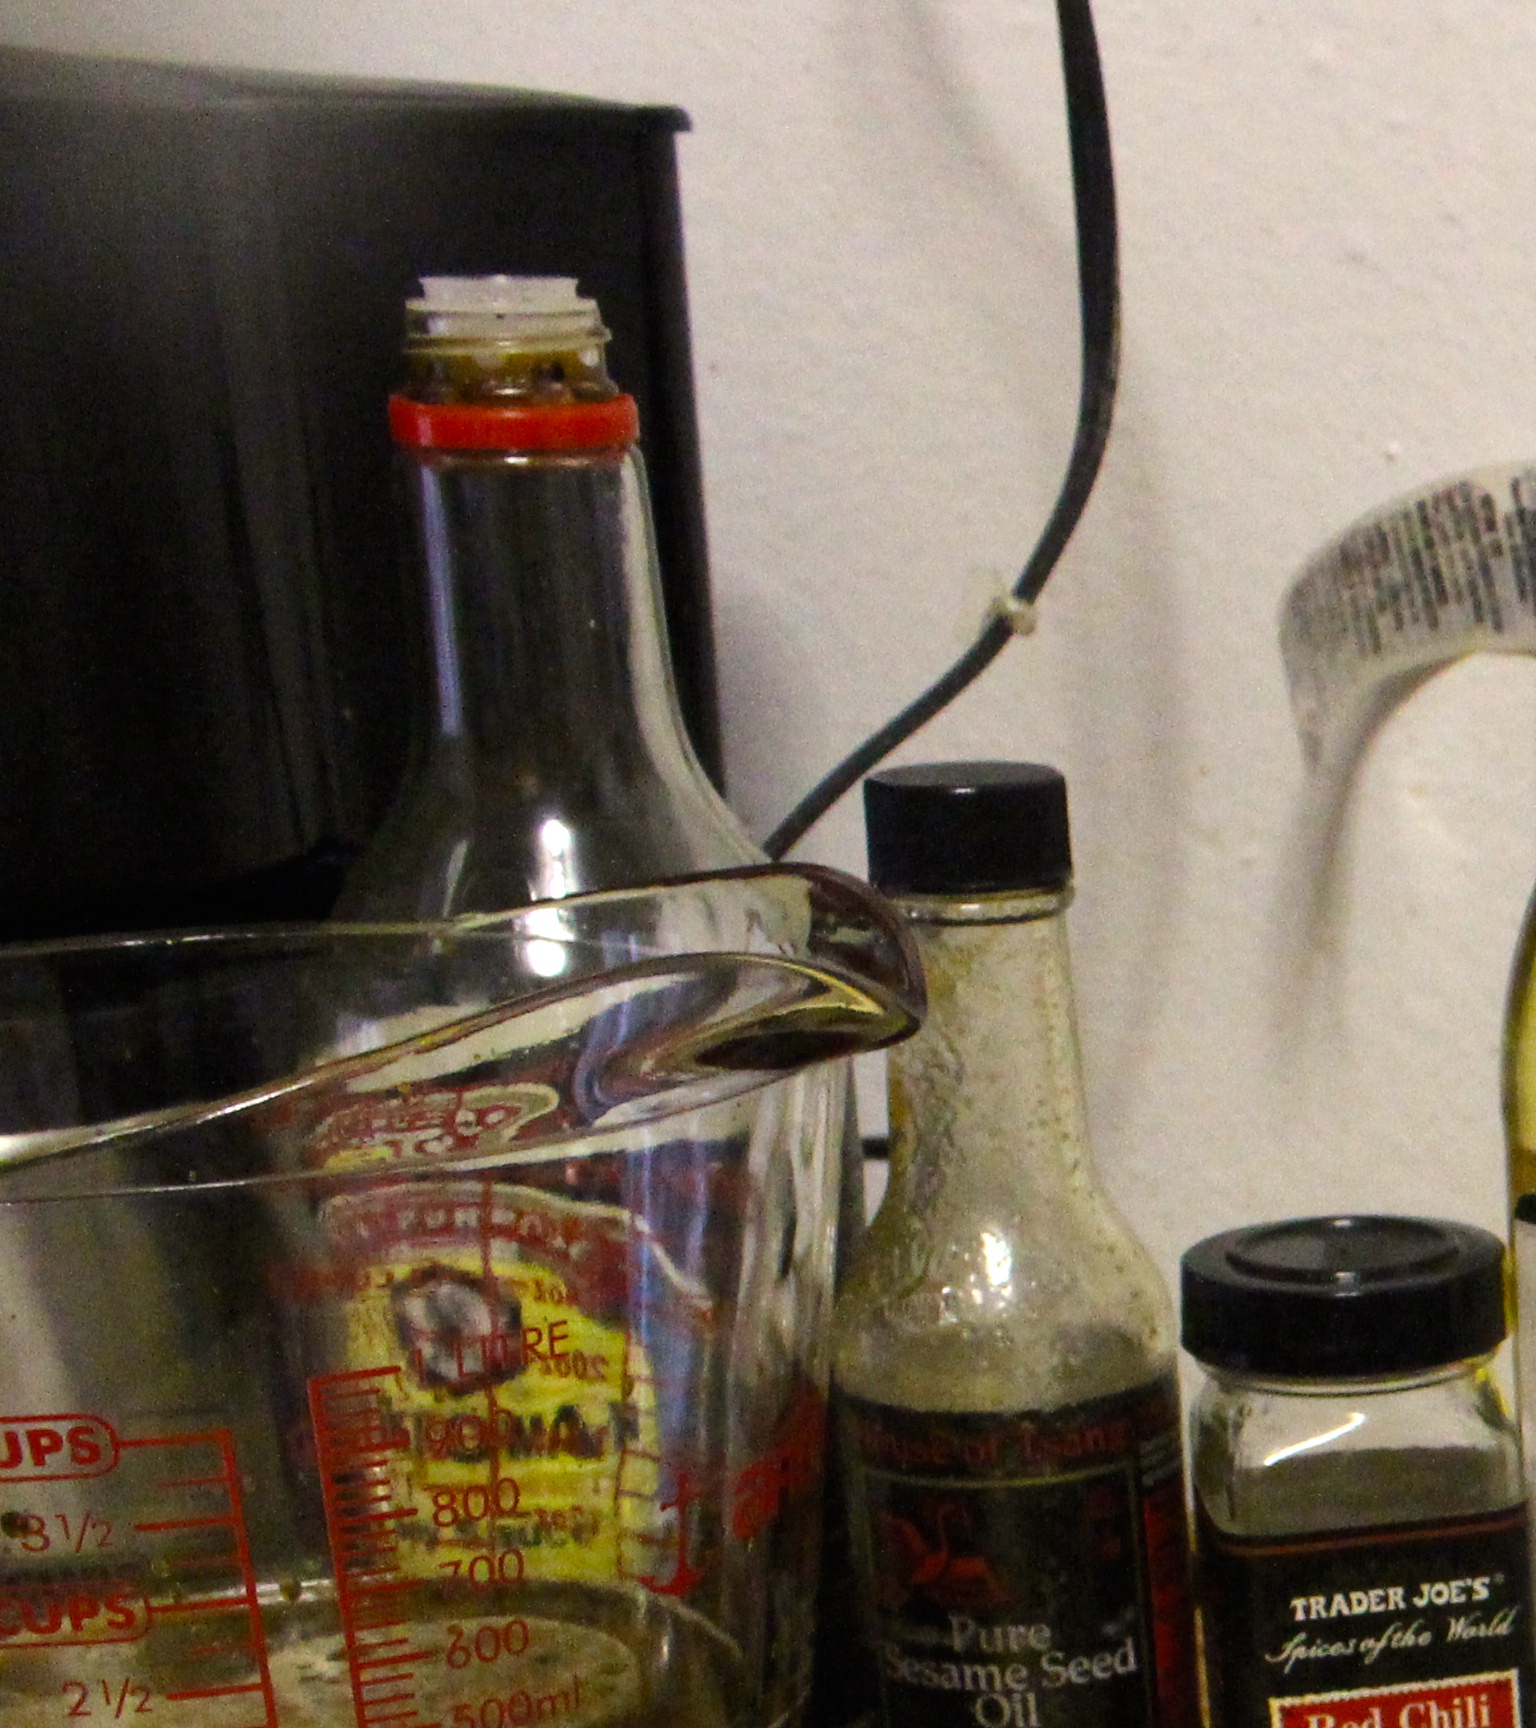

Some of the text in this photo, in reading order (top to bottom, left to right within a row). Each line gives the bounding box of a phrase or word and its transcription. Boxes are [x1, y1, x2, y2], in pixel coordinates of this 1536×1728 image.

[431, 1477, 521, 1528] 800
[438, 1548, 526, 1593] 700
[1289, 1576, 1492, 1622] TRADER JOE'S
[445, 1619, 530, 1670] 600
[949, 1615, 1051, 1652] Pure
[1446, 1604, 1520, 1643] World
[1041, 1637, 1138, 1688] Seed
[975, 1691, 1041, 1728] Oil
